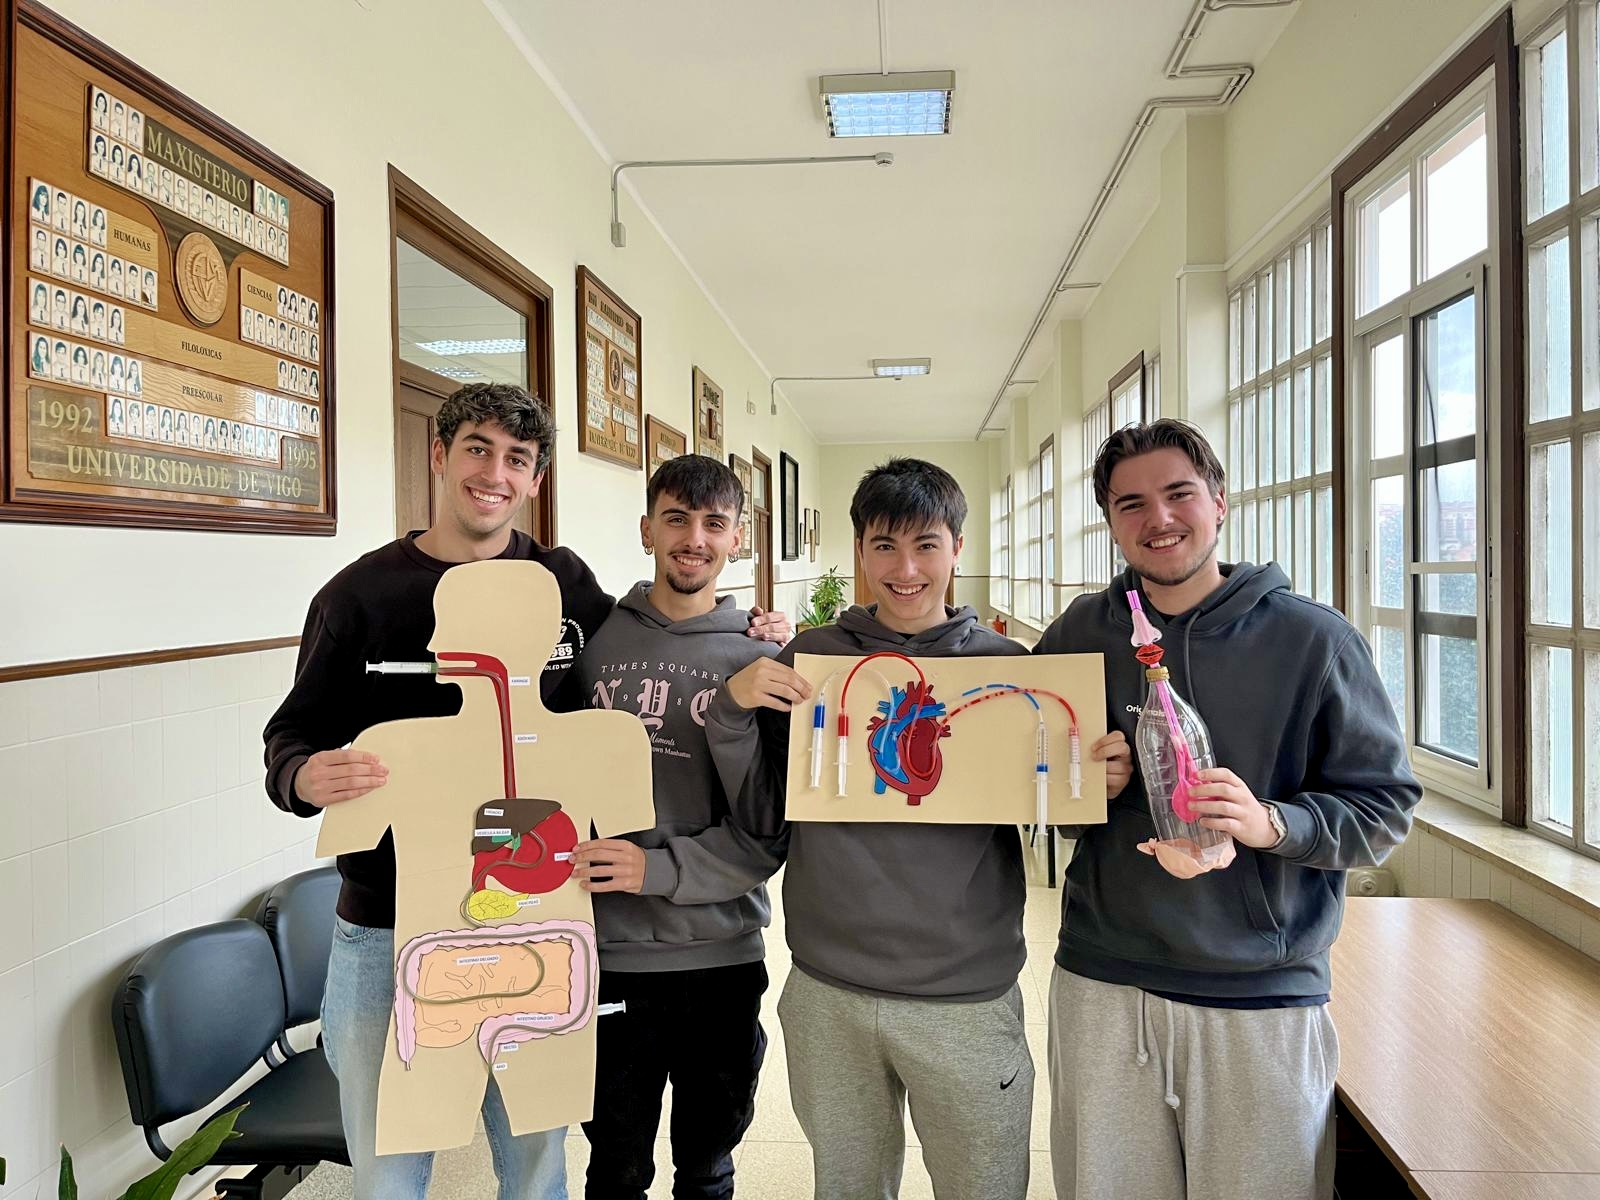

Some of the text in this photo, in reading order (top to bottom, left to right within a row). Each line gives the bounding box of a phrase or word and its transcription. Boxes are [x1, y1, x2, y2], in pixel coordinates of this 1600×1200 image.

[146, 125, 249, 203] MAXISTERIO
[113, 228, 152, 252] HUMANAS
[246, 283, 273, 303] CIENCIAS
[181, 340, 223, 361] FILOLOXICAS
[181, 384, 224, 404] PREESCOLAR
[37, 398, 94, 434] 1992
[287, 445, 317, 470] 1995
[66, 445, 230, 490] UNIVERSIDADE
[238, 470, 260, 494] DE
[266, 474, 303, 498] VIGO
[567, 618, 585, 649] PROGRESS
[551, 646, 573, 658] 989
[601, 661, 719, 681] TIMES SQUARE
